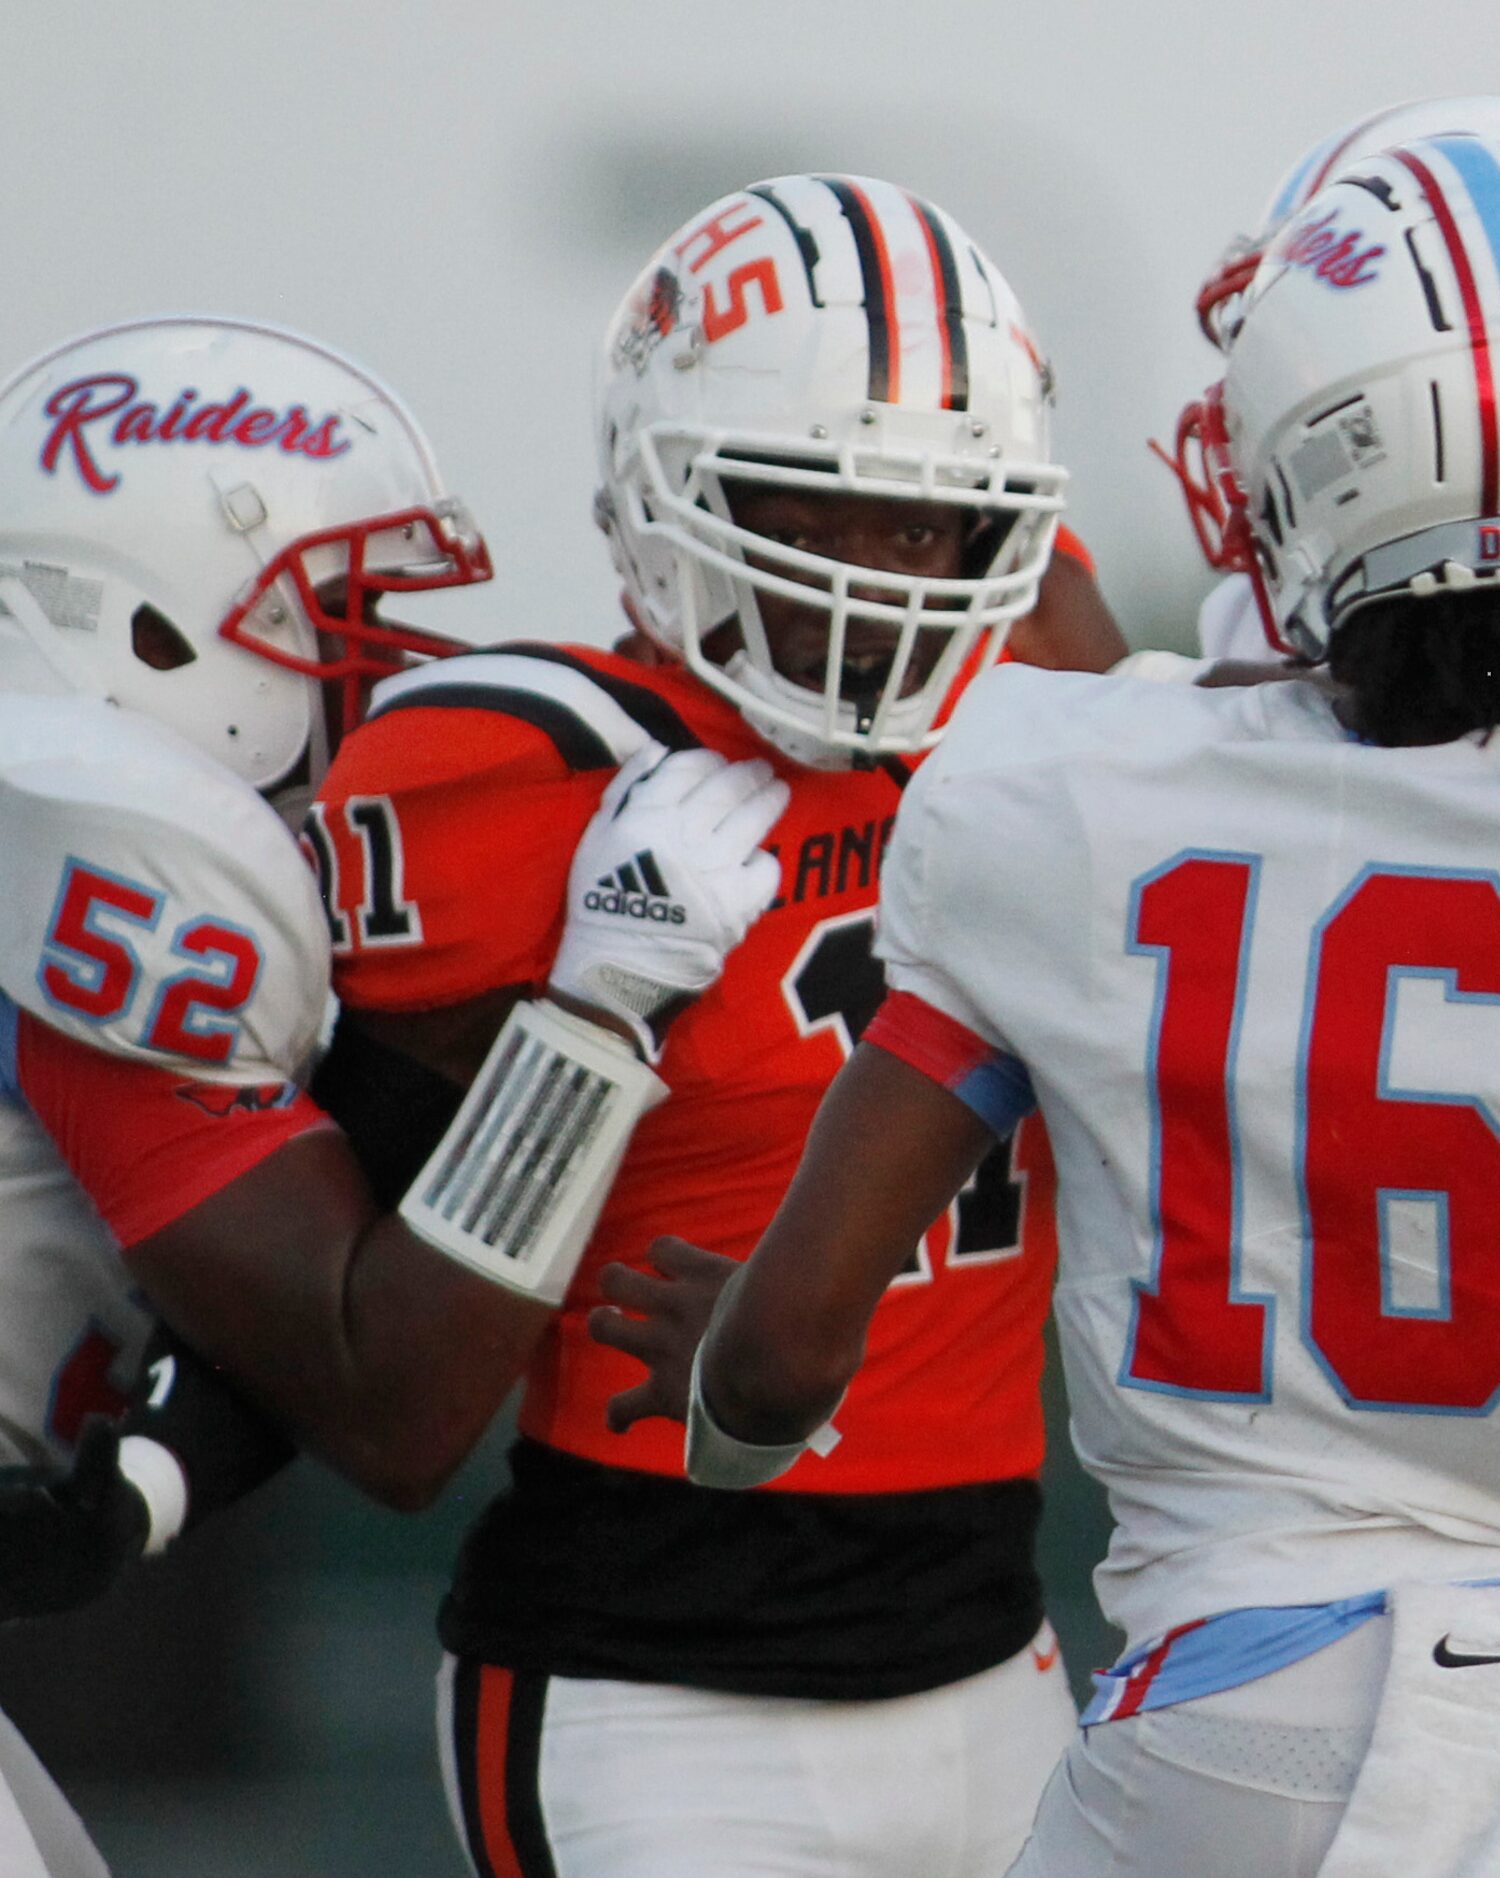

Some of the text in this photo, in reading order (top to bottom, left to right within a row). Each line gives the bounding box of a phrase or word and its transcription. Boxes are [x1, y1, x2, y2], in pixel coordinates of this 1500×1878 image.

[40, 373, 351, 493] Raiders
[36, 854, 266, 1068] 52
[584, 889, 686, 925] adidas
